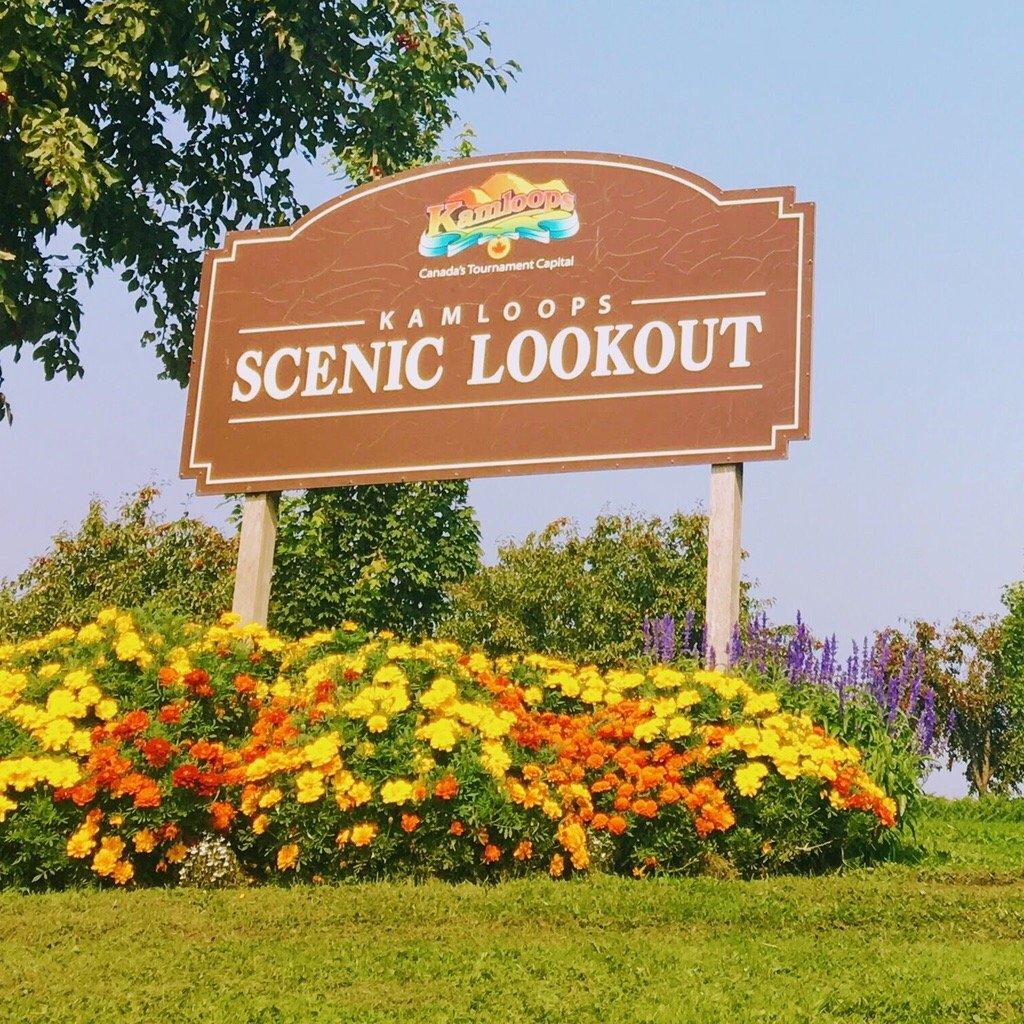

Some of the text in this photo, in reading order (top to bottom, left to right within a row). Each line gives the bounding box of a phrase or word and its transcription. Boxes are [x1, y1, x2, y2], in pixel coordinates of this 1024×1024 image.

[426, 189, 576, 237] Kamloops
[418, 256, 575, 279] Canada's Tournament Capital
[379, 294, 612, 331] KAMLOOPS
[231, 315, 763, 403] SCENIC LOOKOUT
